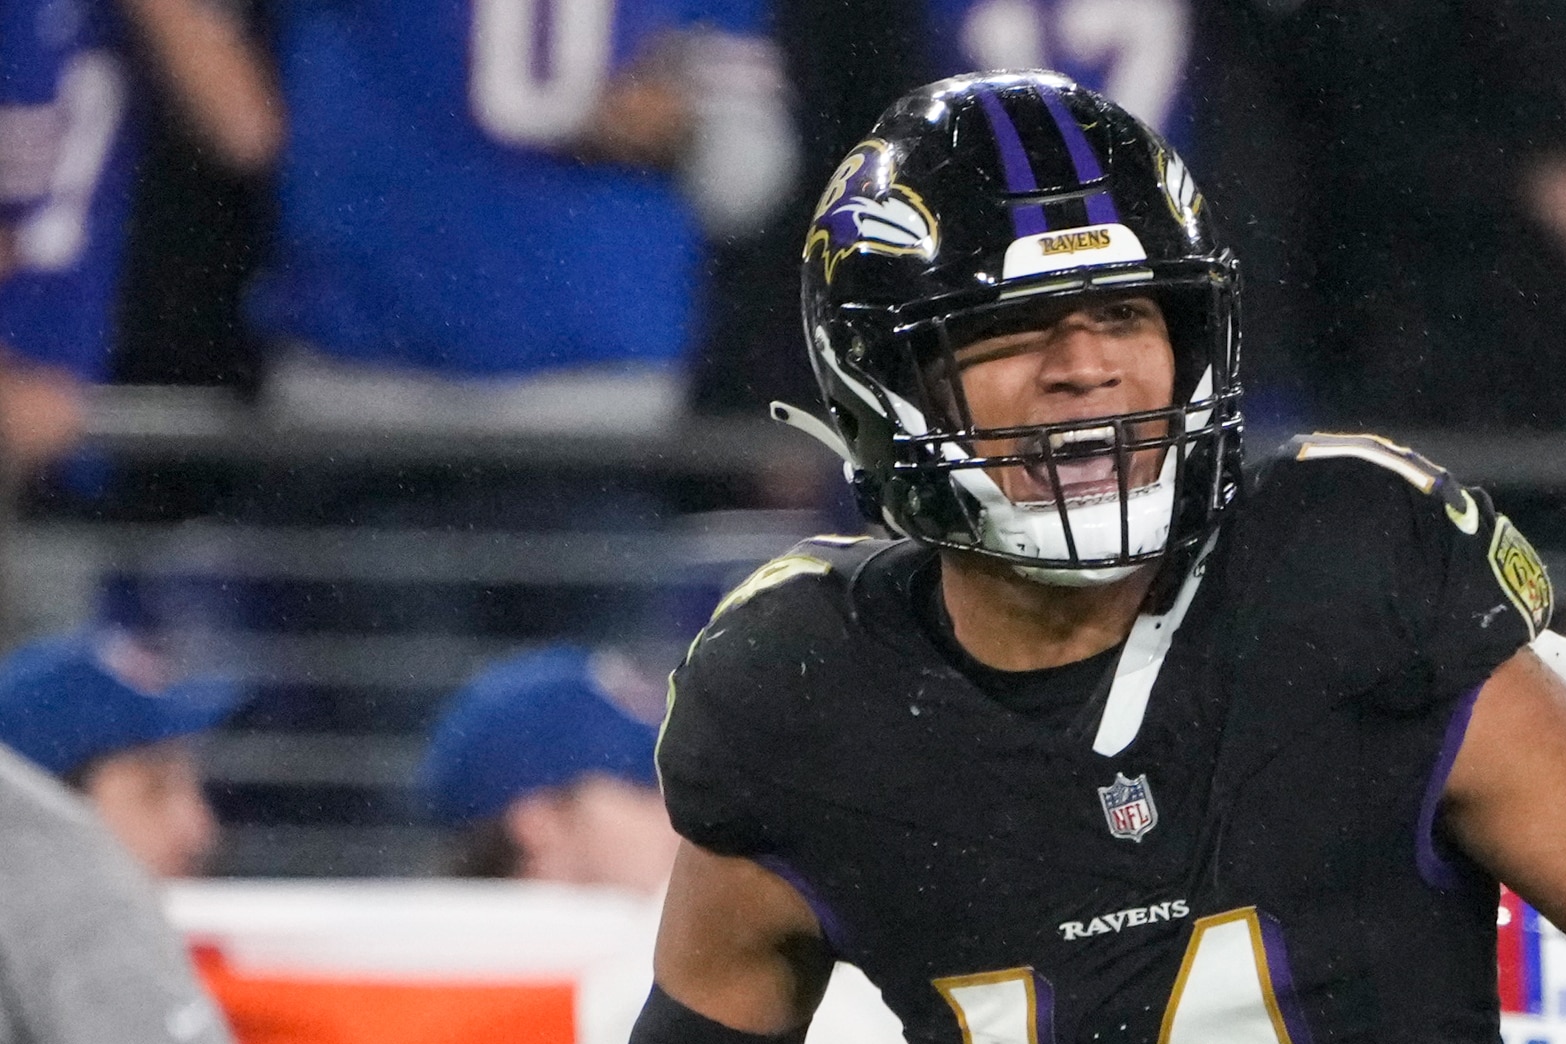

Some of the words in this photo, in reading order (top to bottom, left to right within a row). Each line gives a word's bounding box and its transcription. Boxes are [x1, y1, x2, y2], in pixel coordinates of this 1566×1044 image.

[1038, 228, 1110, 255] RAVENS
[1111, 803, 1150, 831] NFL
[1058, 899, 1190, 941] RAVENS
